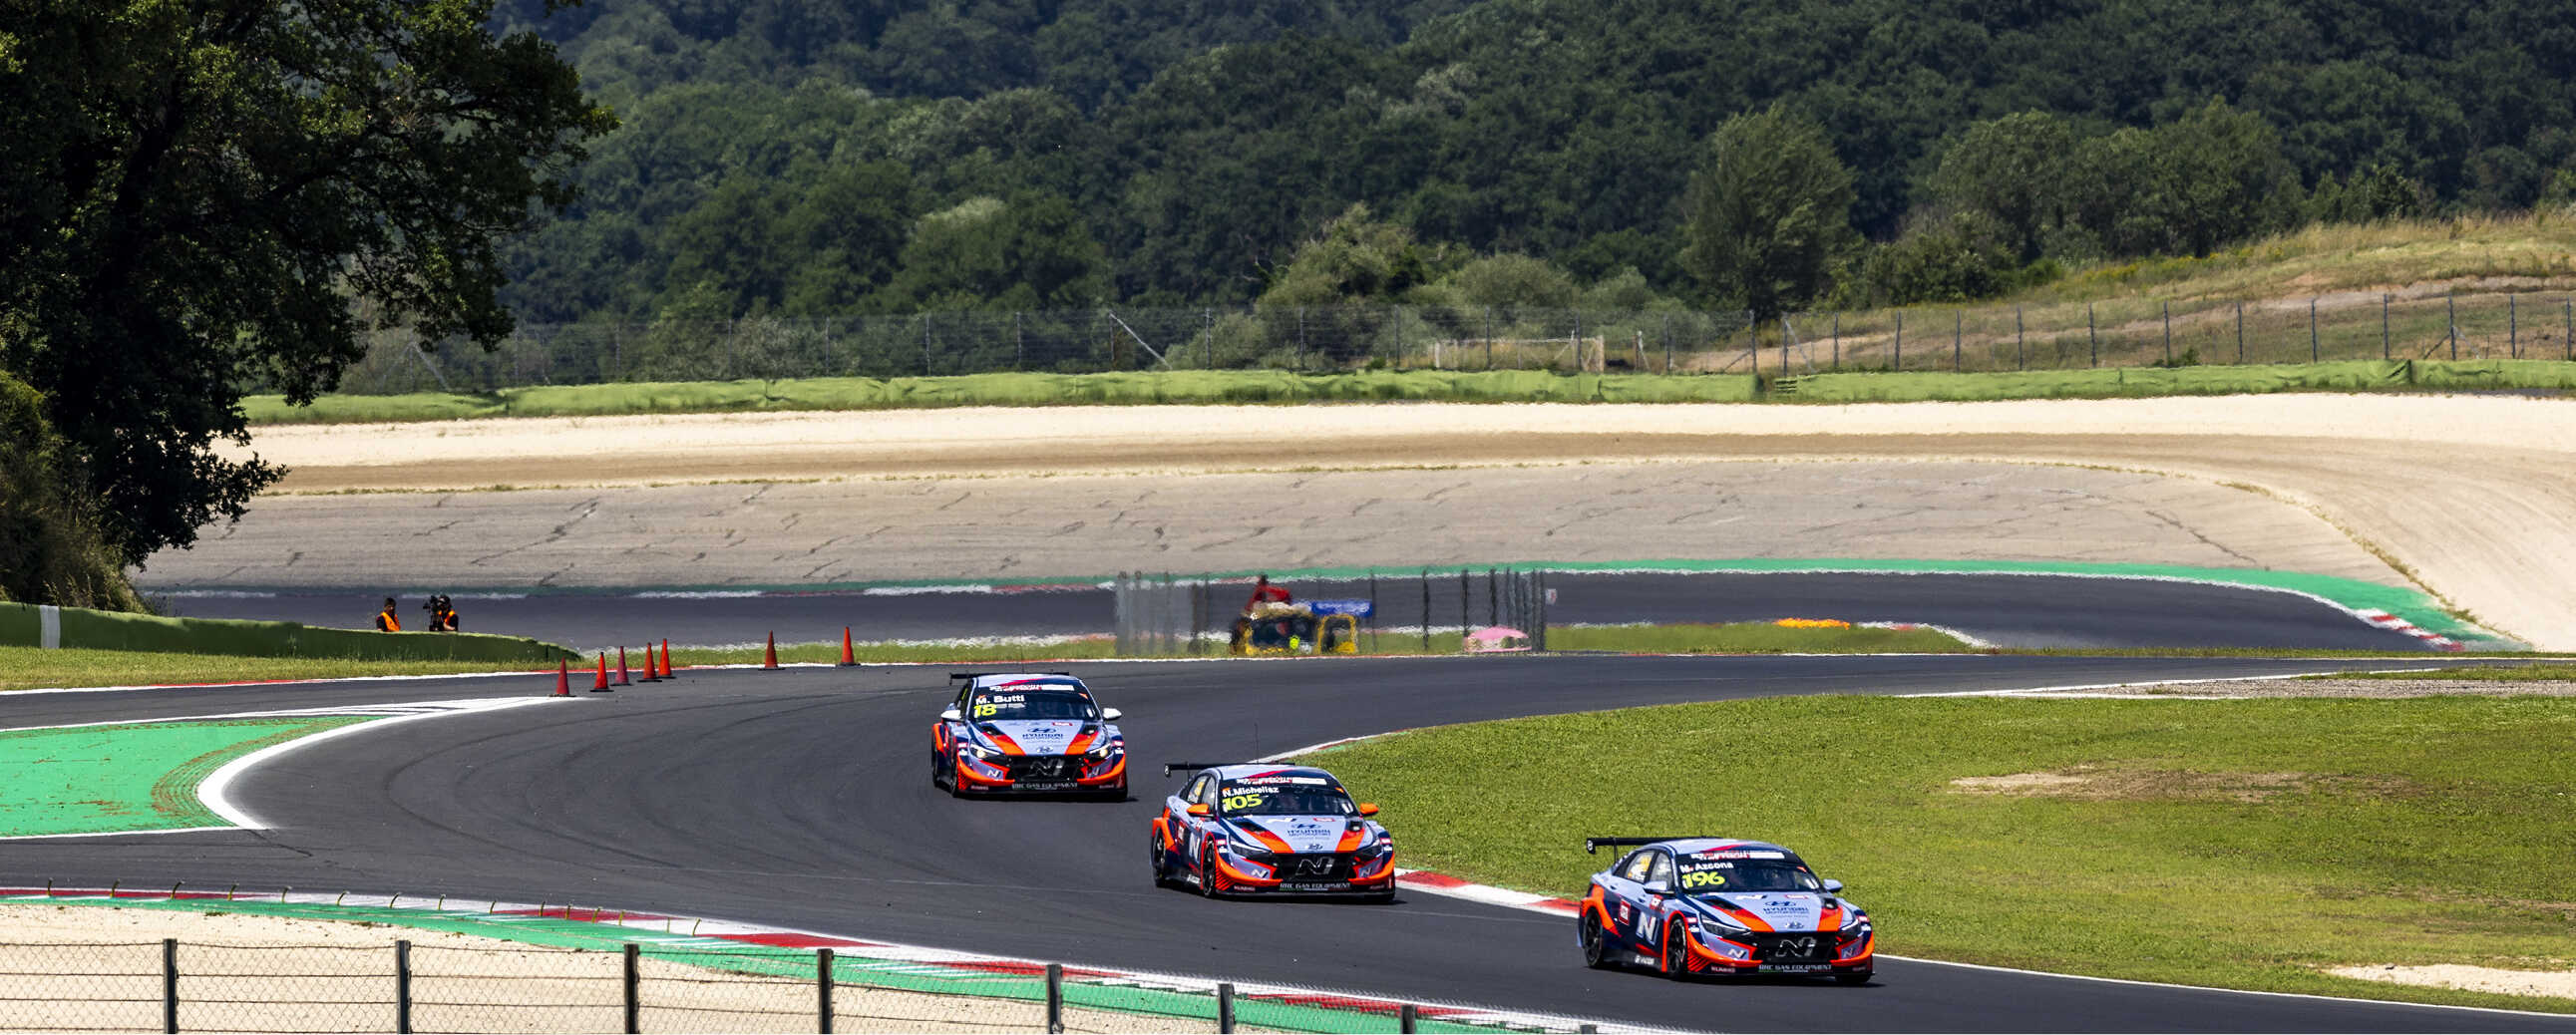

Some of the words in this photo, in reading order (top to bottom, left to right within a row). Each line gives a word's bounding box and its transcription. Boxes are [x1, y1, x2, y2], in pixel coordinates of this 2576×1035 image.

[973, 703, 997, 718] 18
[1222, 794, 1263, 811] 105
[1695, 862, 1734, 871] Azcona
[1681, 870, 1725, 888] 196
[1636, 910, 1659, 945] N
